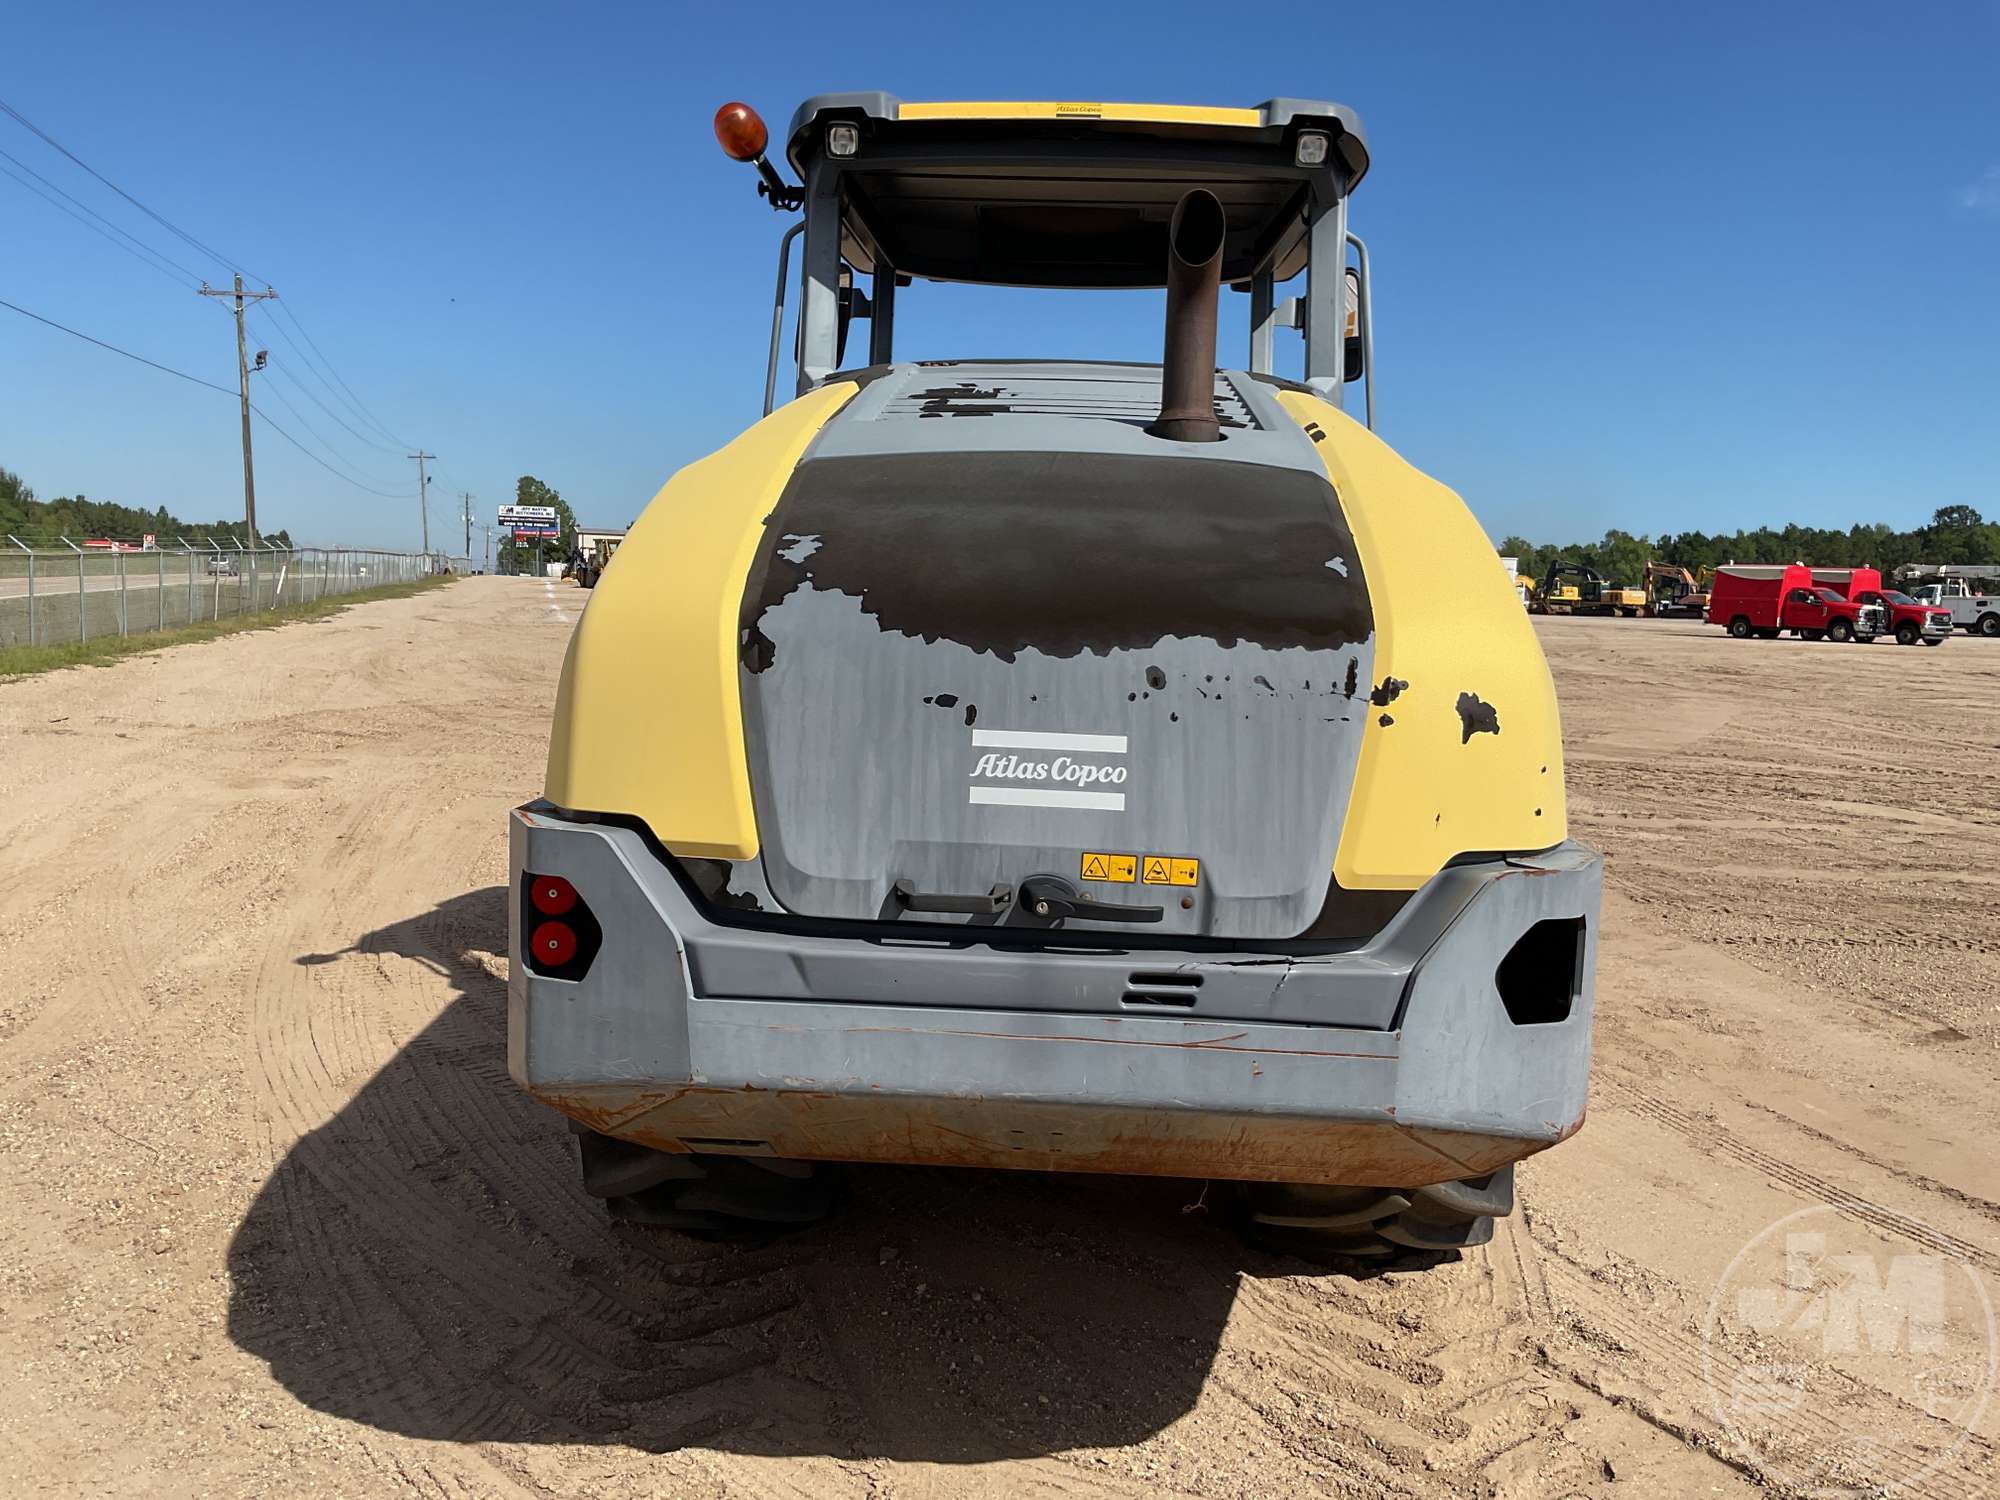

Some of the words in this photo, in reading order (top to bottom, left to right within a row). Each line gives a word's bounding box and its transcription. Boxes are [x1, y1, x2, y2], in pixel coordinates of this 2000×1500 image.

[1056, 105, 1078, 113] Atlas
[969, 753, 1049, 780] Atlas
[1050, 756, 1127, 787] Copco
